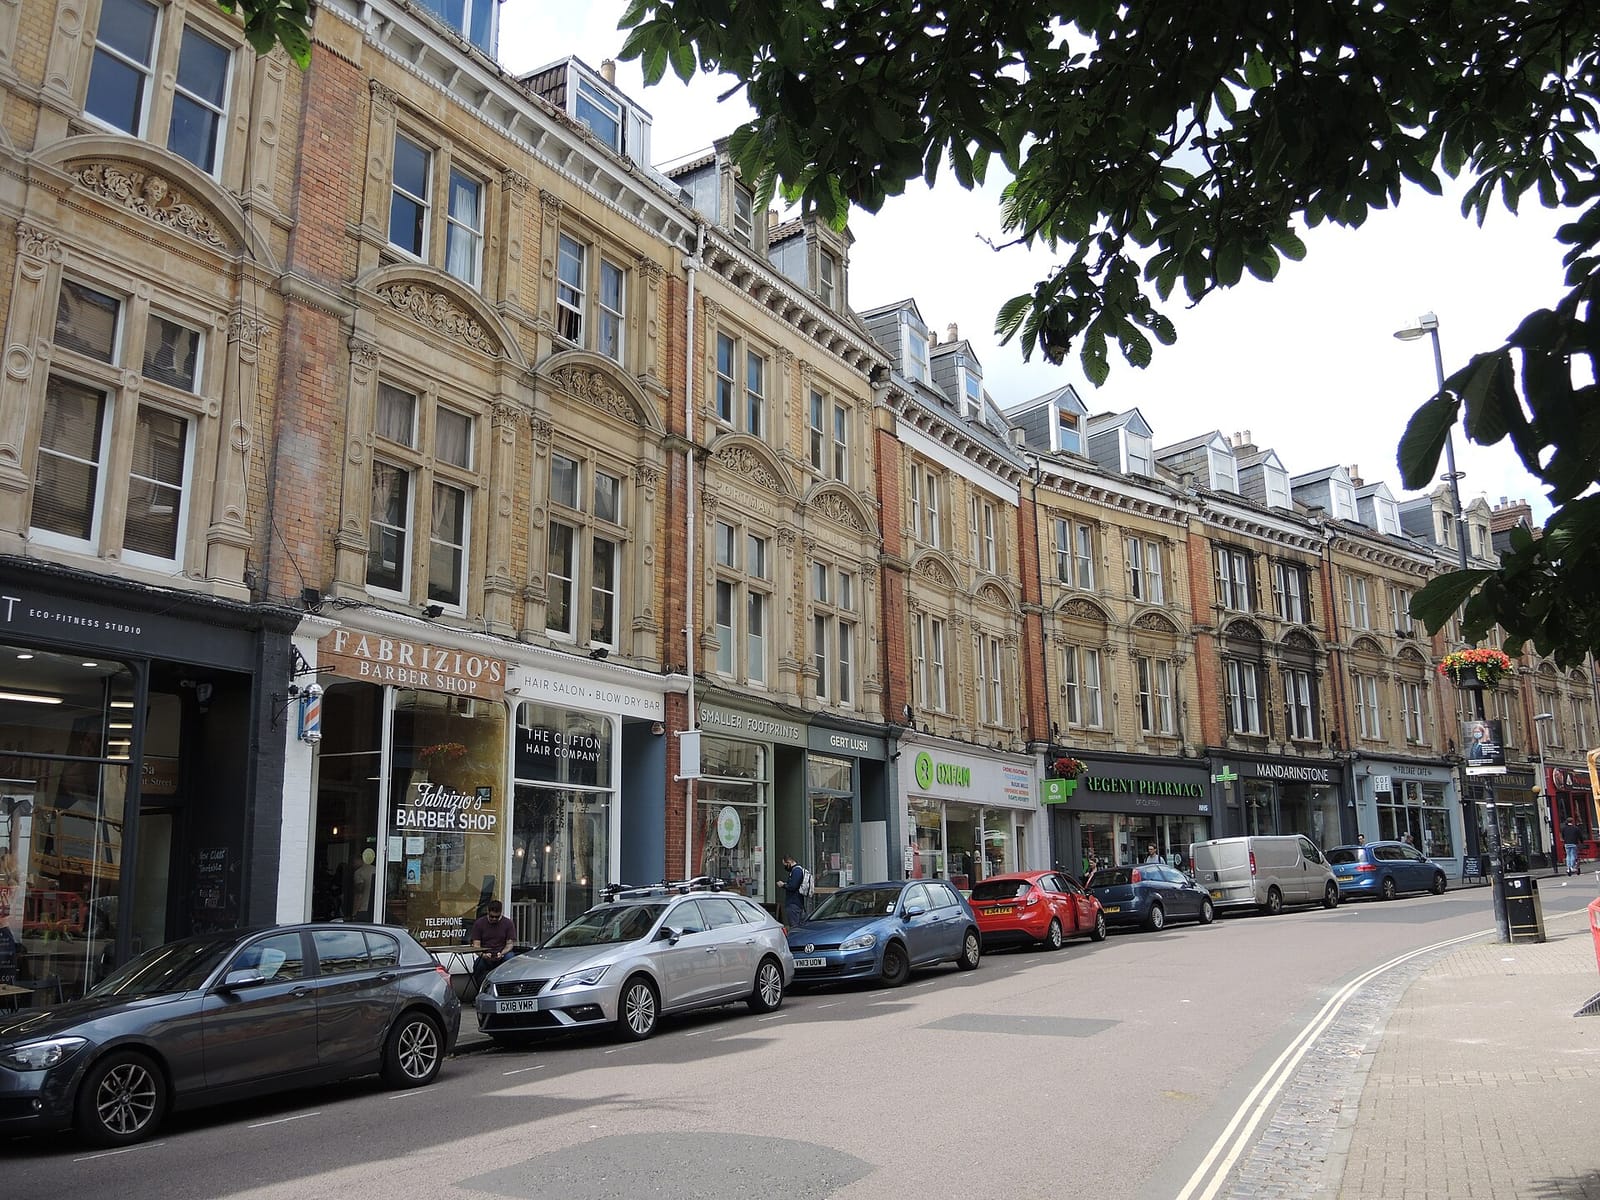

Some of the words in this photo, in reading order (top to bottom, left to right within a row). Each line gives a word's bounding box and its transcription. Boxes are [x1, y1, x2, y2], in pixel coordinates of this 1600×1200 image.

[29, 608, 100, 628] ECO-FITNESS
[104, 622, 141, 635] STUDIO
[333, 629, 501, 682] FABRIZIO'S
[360, 661, 429, 686] BARBER
[437, 675, 477, 694] SHOP
[524, 676, 549, 690] HAIR
[553, 682, 585, 697] SALON
[595, 690, 622, 704] BLOW
[624, 695, 642, 709] DRY
[644, 699, 660, 711] BAR
[701, 708, 743, 729] SMALLER
[747, 718, 799, 740] FOOTPRINTS
[527, 728, 549, 742] THE
[554, 732, 601, 749] CLIFTON
[830, 735, 849, 749] GERT
[850, 739, 868, 752] LUSH
[526, 743, 550, 756] HAIR
[554, 747, 601, 763] COMPANY
[936, 762, 971, 788] OXFAM
[1256, 763, 1329, 782] MANDARINSTONE
[1087, 776, 1136, 793] REGENT
[1139, 780, 1205, 798] PHARMACY
[414, 783, 482, 817] Fabrizio's
[396, 808, 455, 829] BARBER
[458, 812, 497, 830] SHOP
[425, 917, 463, 927] TELEPHONE
[420, 929, 440, 939] 07417
[442, 928, 467, 938] 504707
